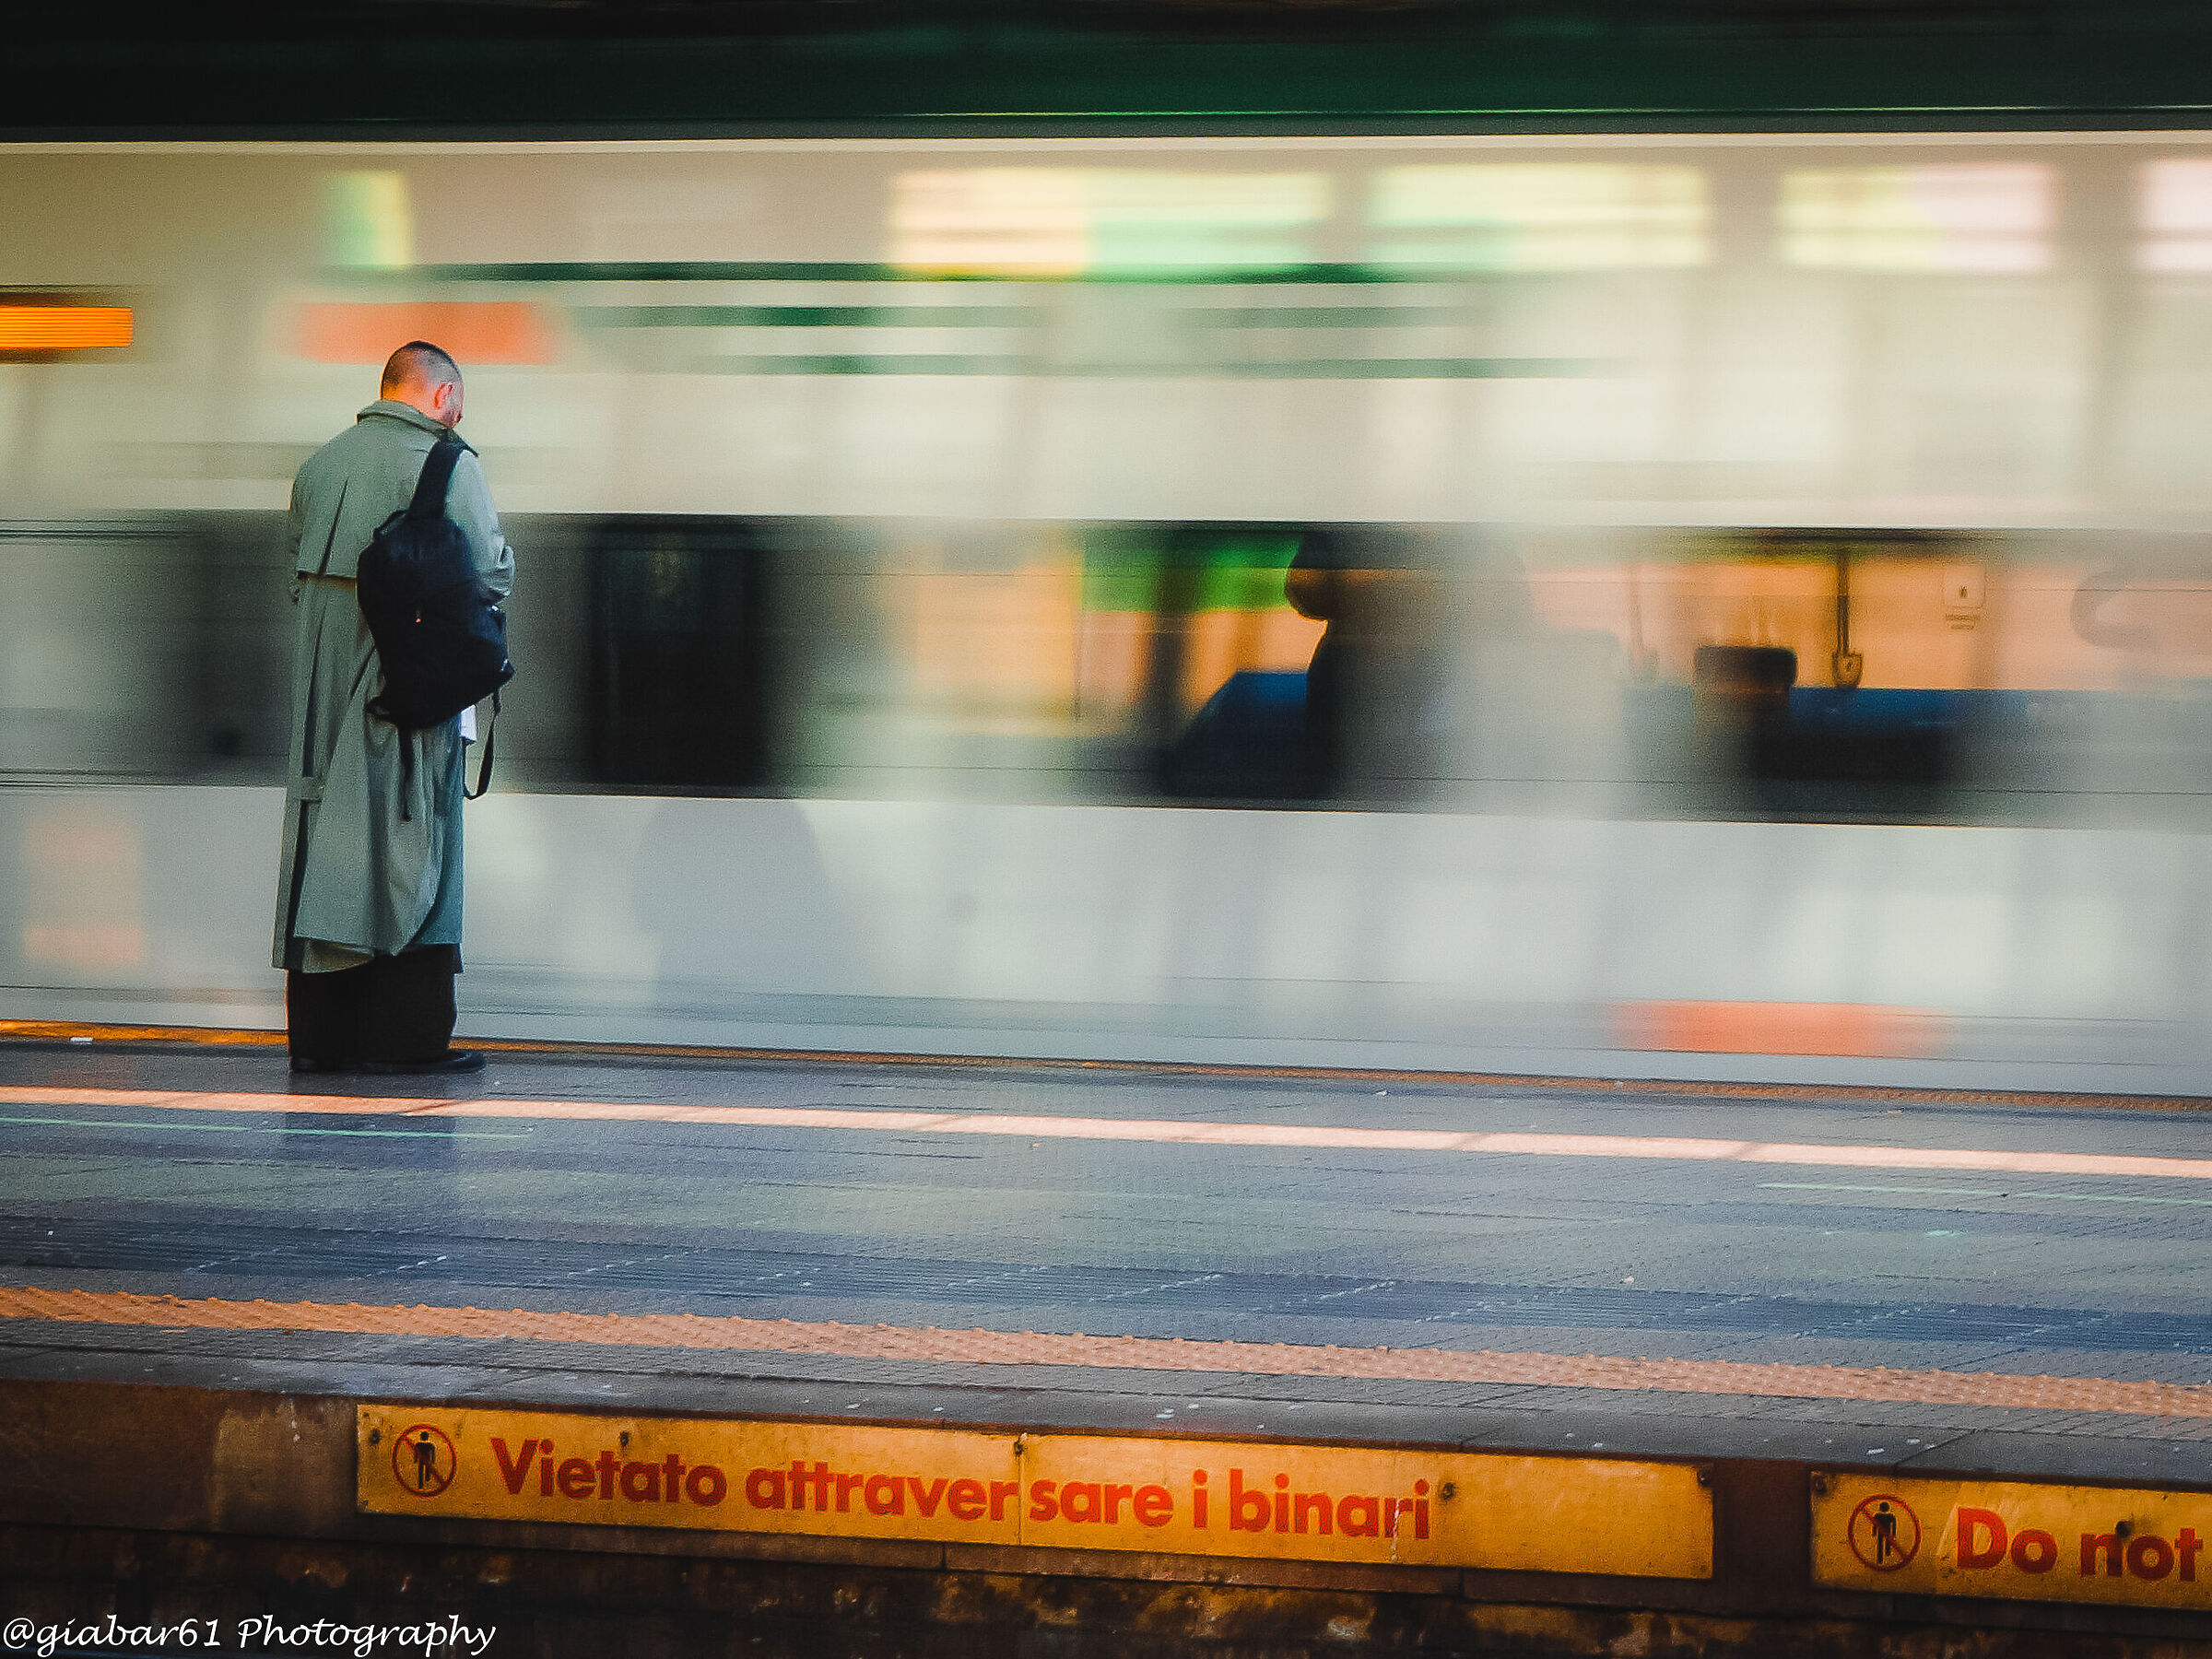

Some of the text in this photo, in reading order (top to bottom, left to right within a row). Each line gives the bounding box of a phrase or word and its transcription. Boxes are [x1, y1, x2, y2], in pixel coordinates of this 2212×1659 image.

[489, 1438, 728, 1507] Vietato
[1193, 1469, 1208, 1528] i
[1229, 1468, 1430, 1540] binari
[1957, 1506, 2204, 1583] Do not
